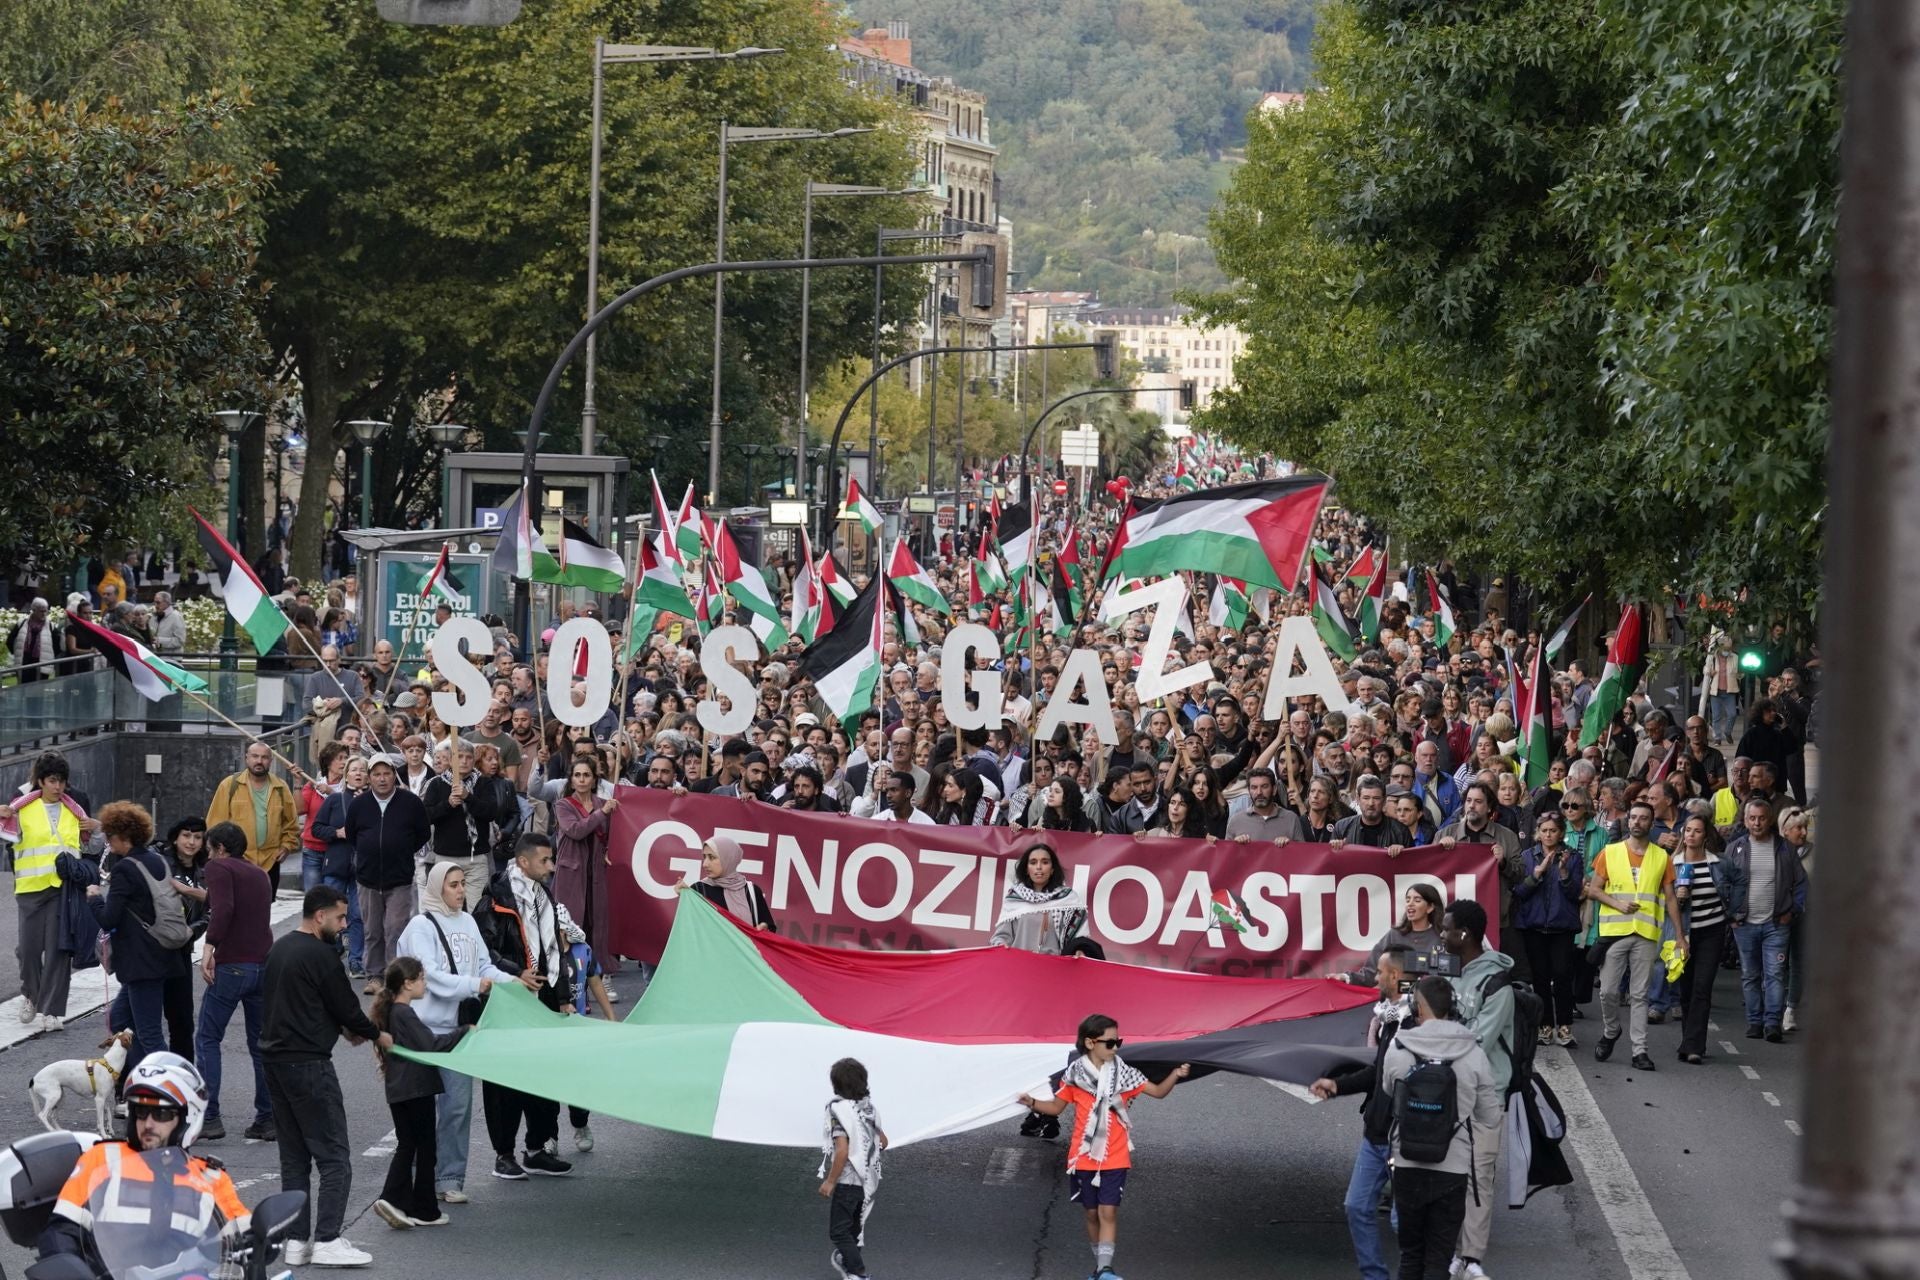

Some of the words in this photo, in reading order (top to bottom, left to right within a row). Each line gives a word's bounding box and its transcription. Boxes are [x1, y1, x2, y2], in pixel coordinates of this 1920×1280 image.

[484, 512, 499, 529] P
[431, 617, 759, 735] SOS
[941, 575, 1350, 745] GAZA
[631, 820, 1226, 949] GNOZIIOA
[1238, 872, 1477, 953] STOP
